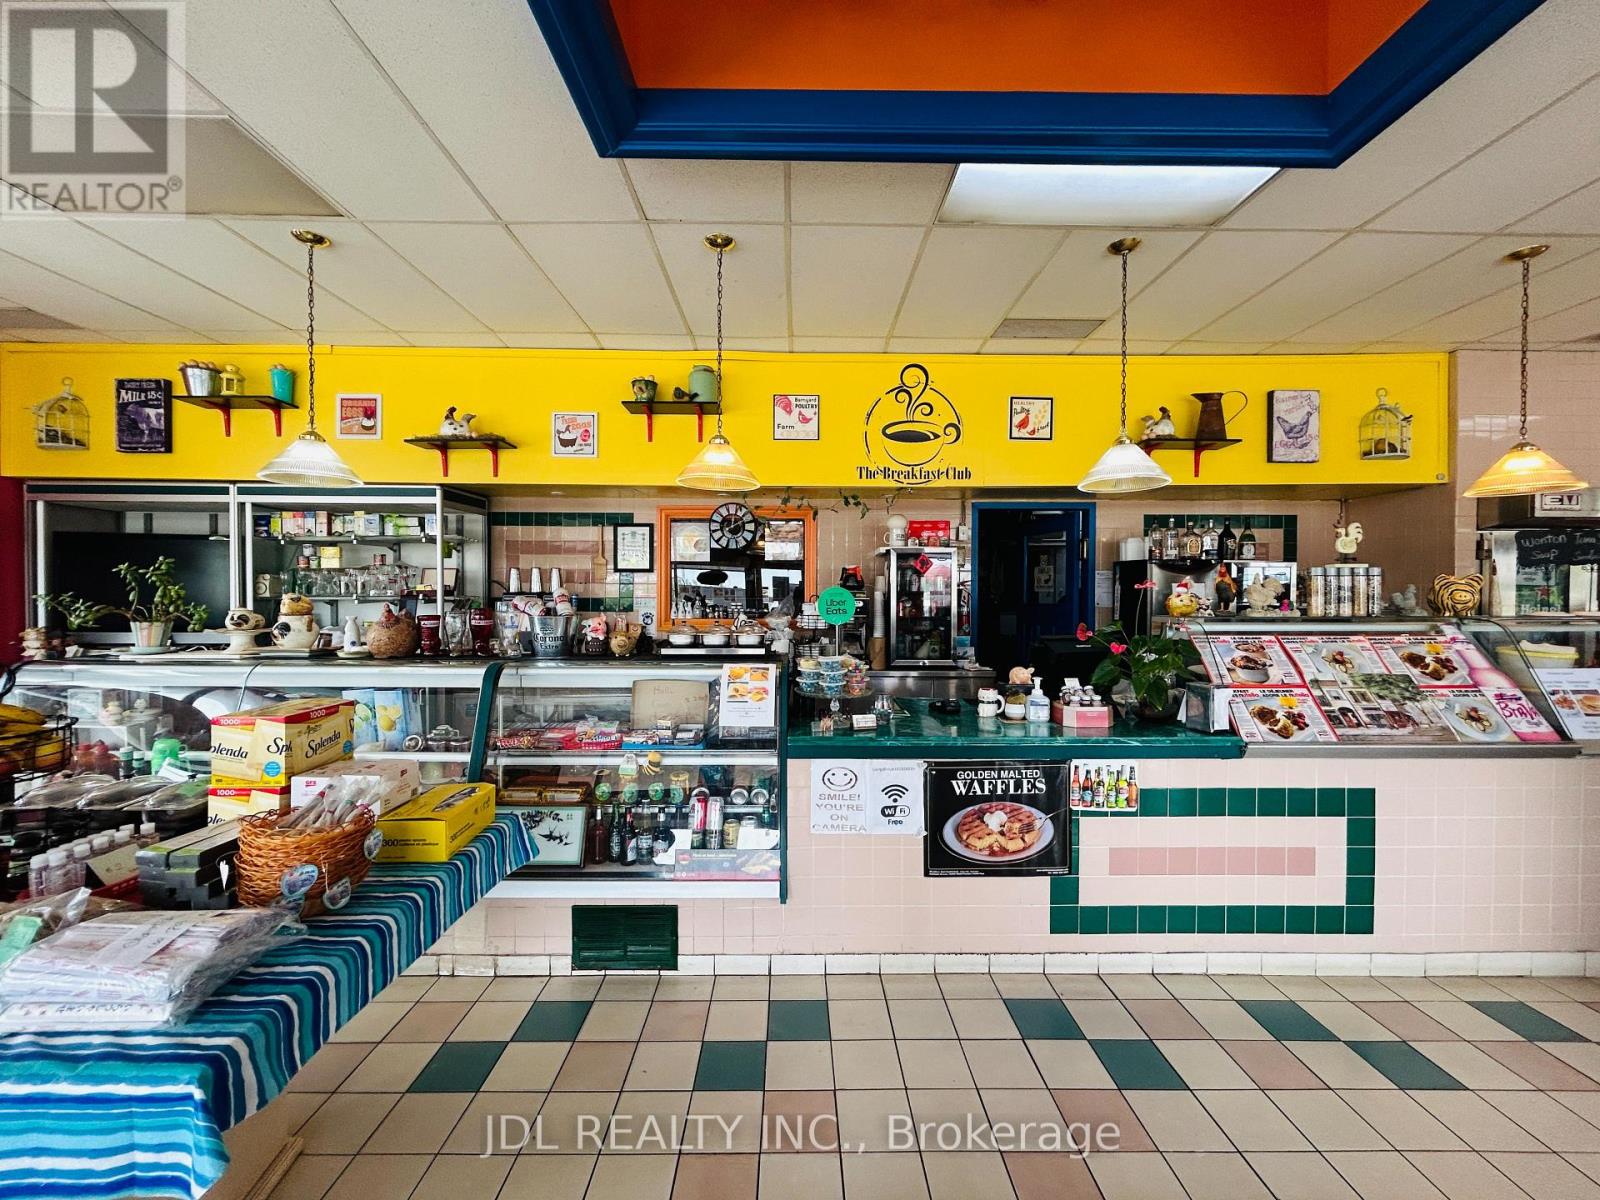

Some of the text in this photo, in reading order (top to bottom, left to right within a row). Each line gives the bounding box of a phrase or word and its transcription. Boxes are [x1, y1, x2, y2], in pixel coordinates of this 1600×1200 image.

[119, 389, 146, 403] MILK
[856, 466, 972, 480] The Breakfast Club
[825, 599, 847, 607] Uber
[534, 633, 565, 642] Corona
[310, 709, 326, 718] 1000
[219, 718, 240, 726] 1000
[305, 730, 341, 759] Splenda
[956, 769, 1040, 780] GOLDEN MALTED
[950, 778, 1047, 796] WAFFLES
[818, 793, 861, 801] SMILE!
[815, 803, 865, 812] YOU'RE
[830, 813, 849, 821] ON
[812, 823, 867, 832] CAMERA
